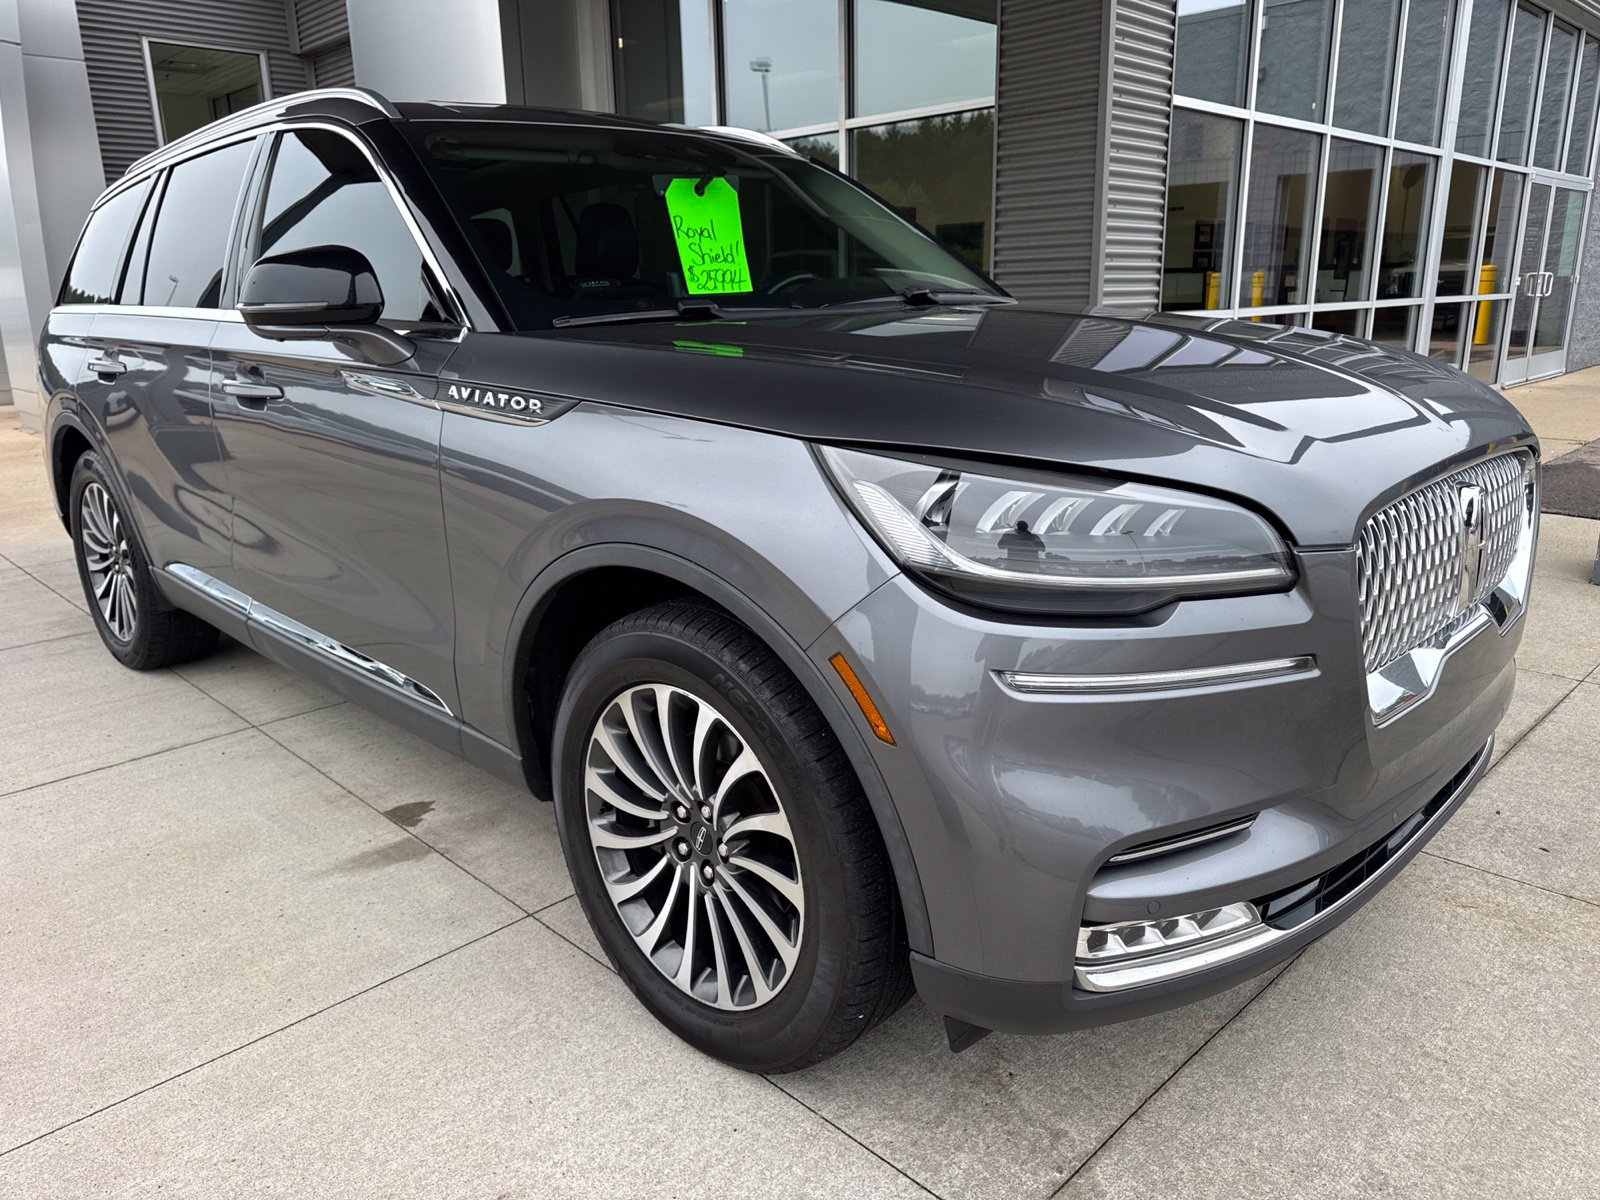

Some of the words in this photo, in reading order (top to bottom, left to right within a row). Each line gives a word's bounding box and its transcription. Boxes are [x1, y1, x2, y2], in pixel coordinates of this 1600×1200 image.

[673, 215, 717, 242] Royal
[688, 240, 741, 266] Shield!
[448, 385, 542, 415] AVIATOR
